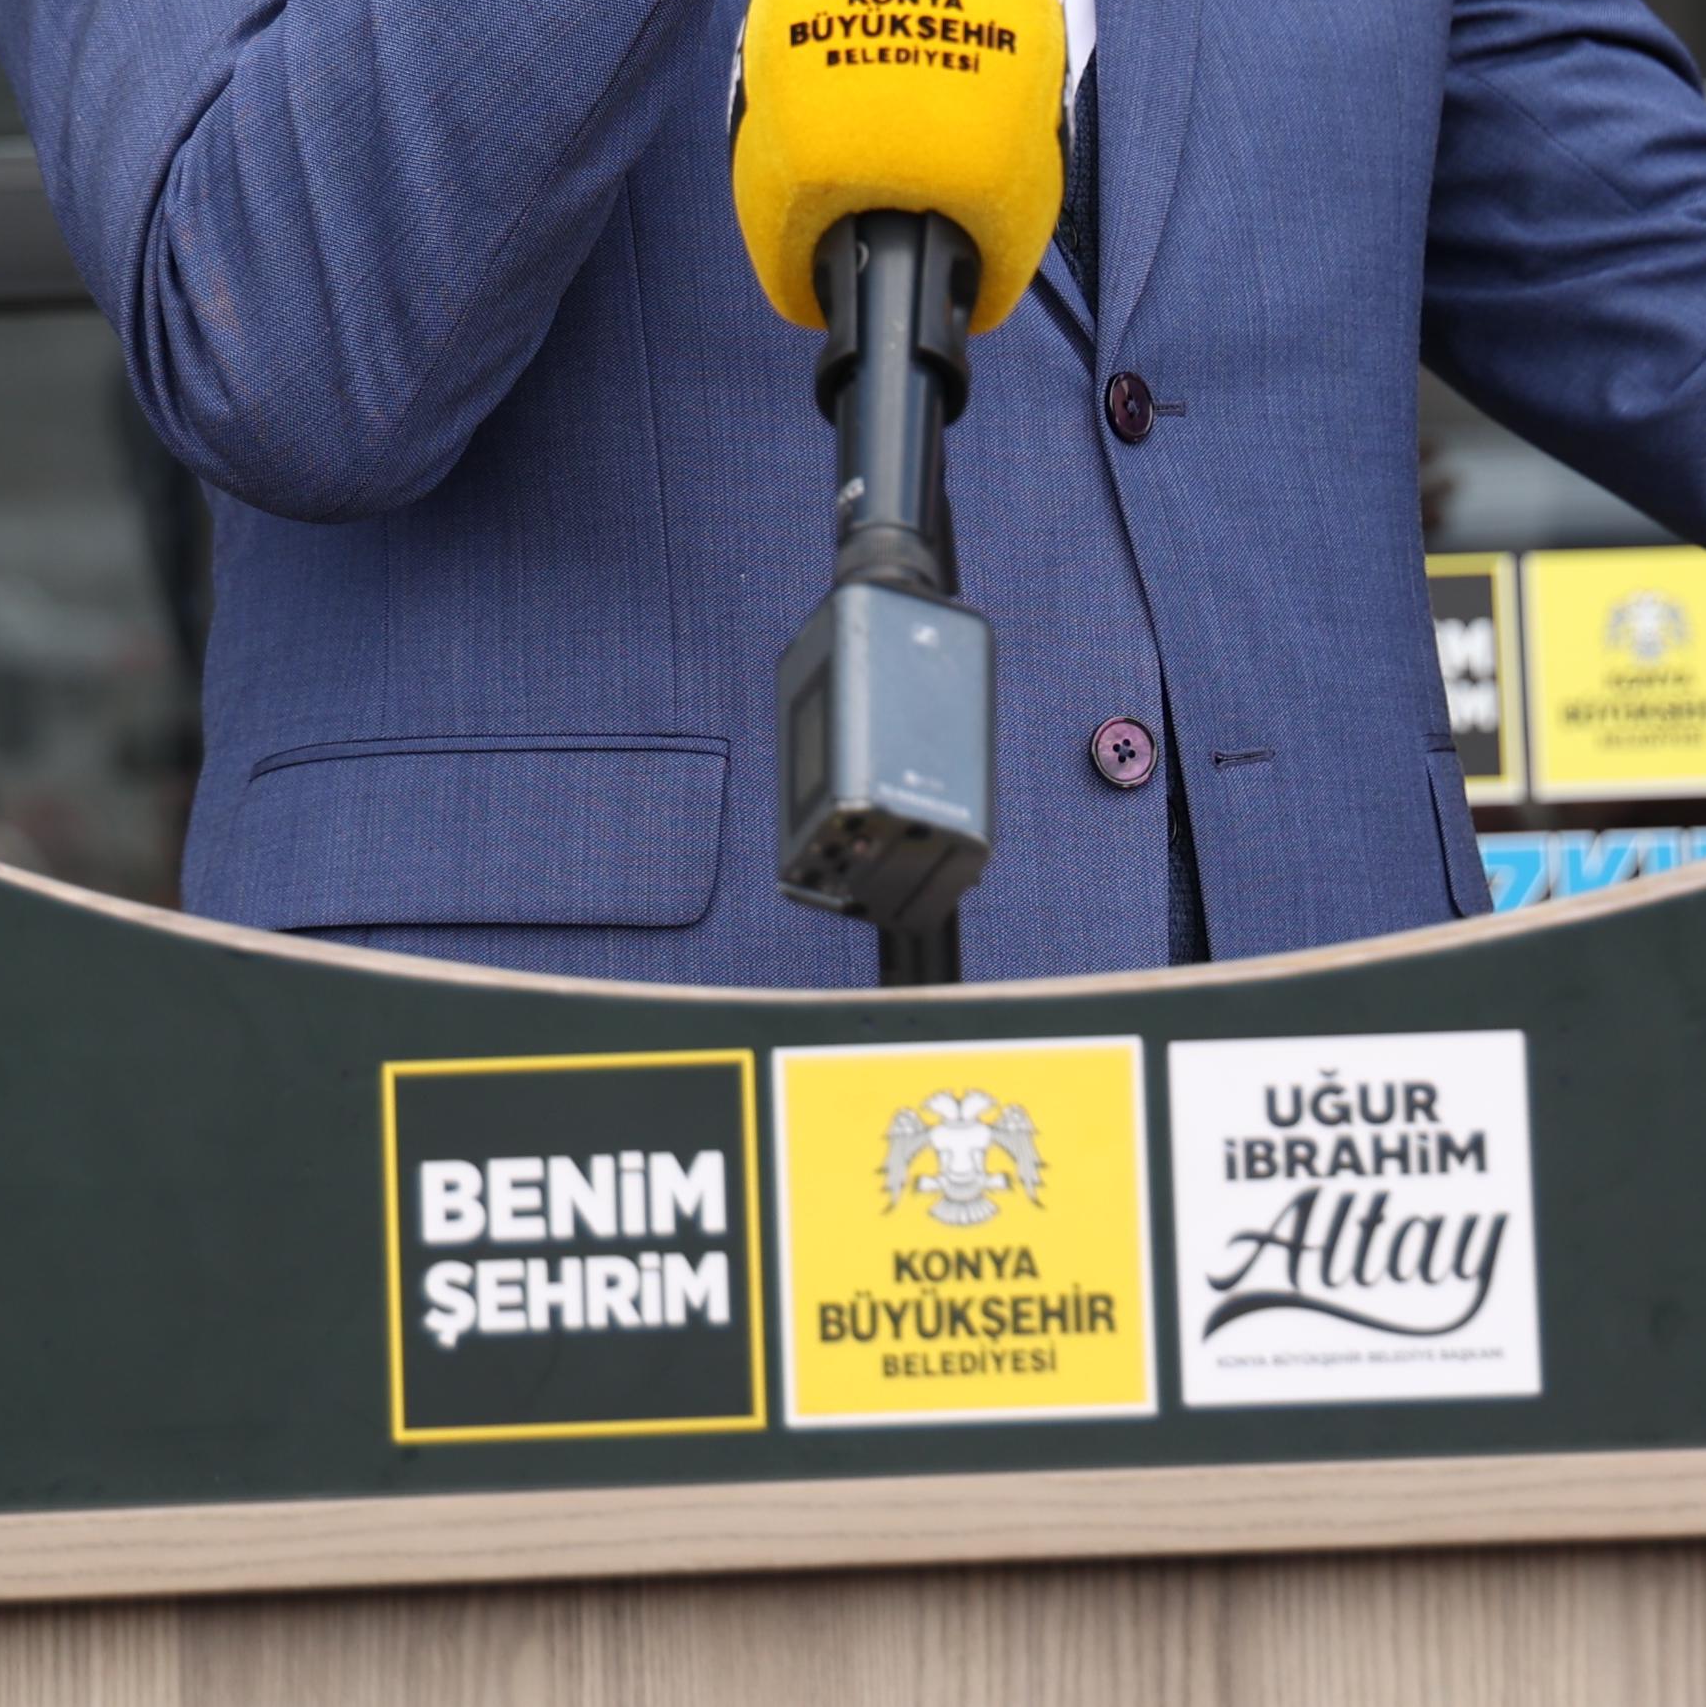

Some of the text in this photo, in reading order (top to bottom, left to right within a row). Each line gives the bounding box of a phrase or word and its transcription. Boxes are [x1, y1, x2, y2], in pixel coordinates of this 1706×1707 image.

[825, 45, 981, 75] BELEDİYESİ
[1264, 1067, 1440, 1128] UĞUR
[893, 1245, 1041, 1284] KONYA
[1202, 1184, 1510, 1343] Altay
[818, 1281, 1118, 1344] BÜYÜKŞEHİR
[881, 1340, 1058, 1379] BELEDİYESİ
